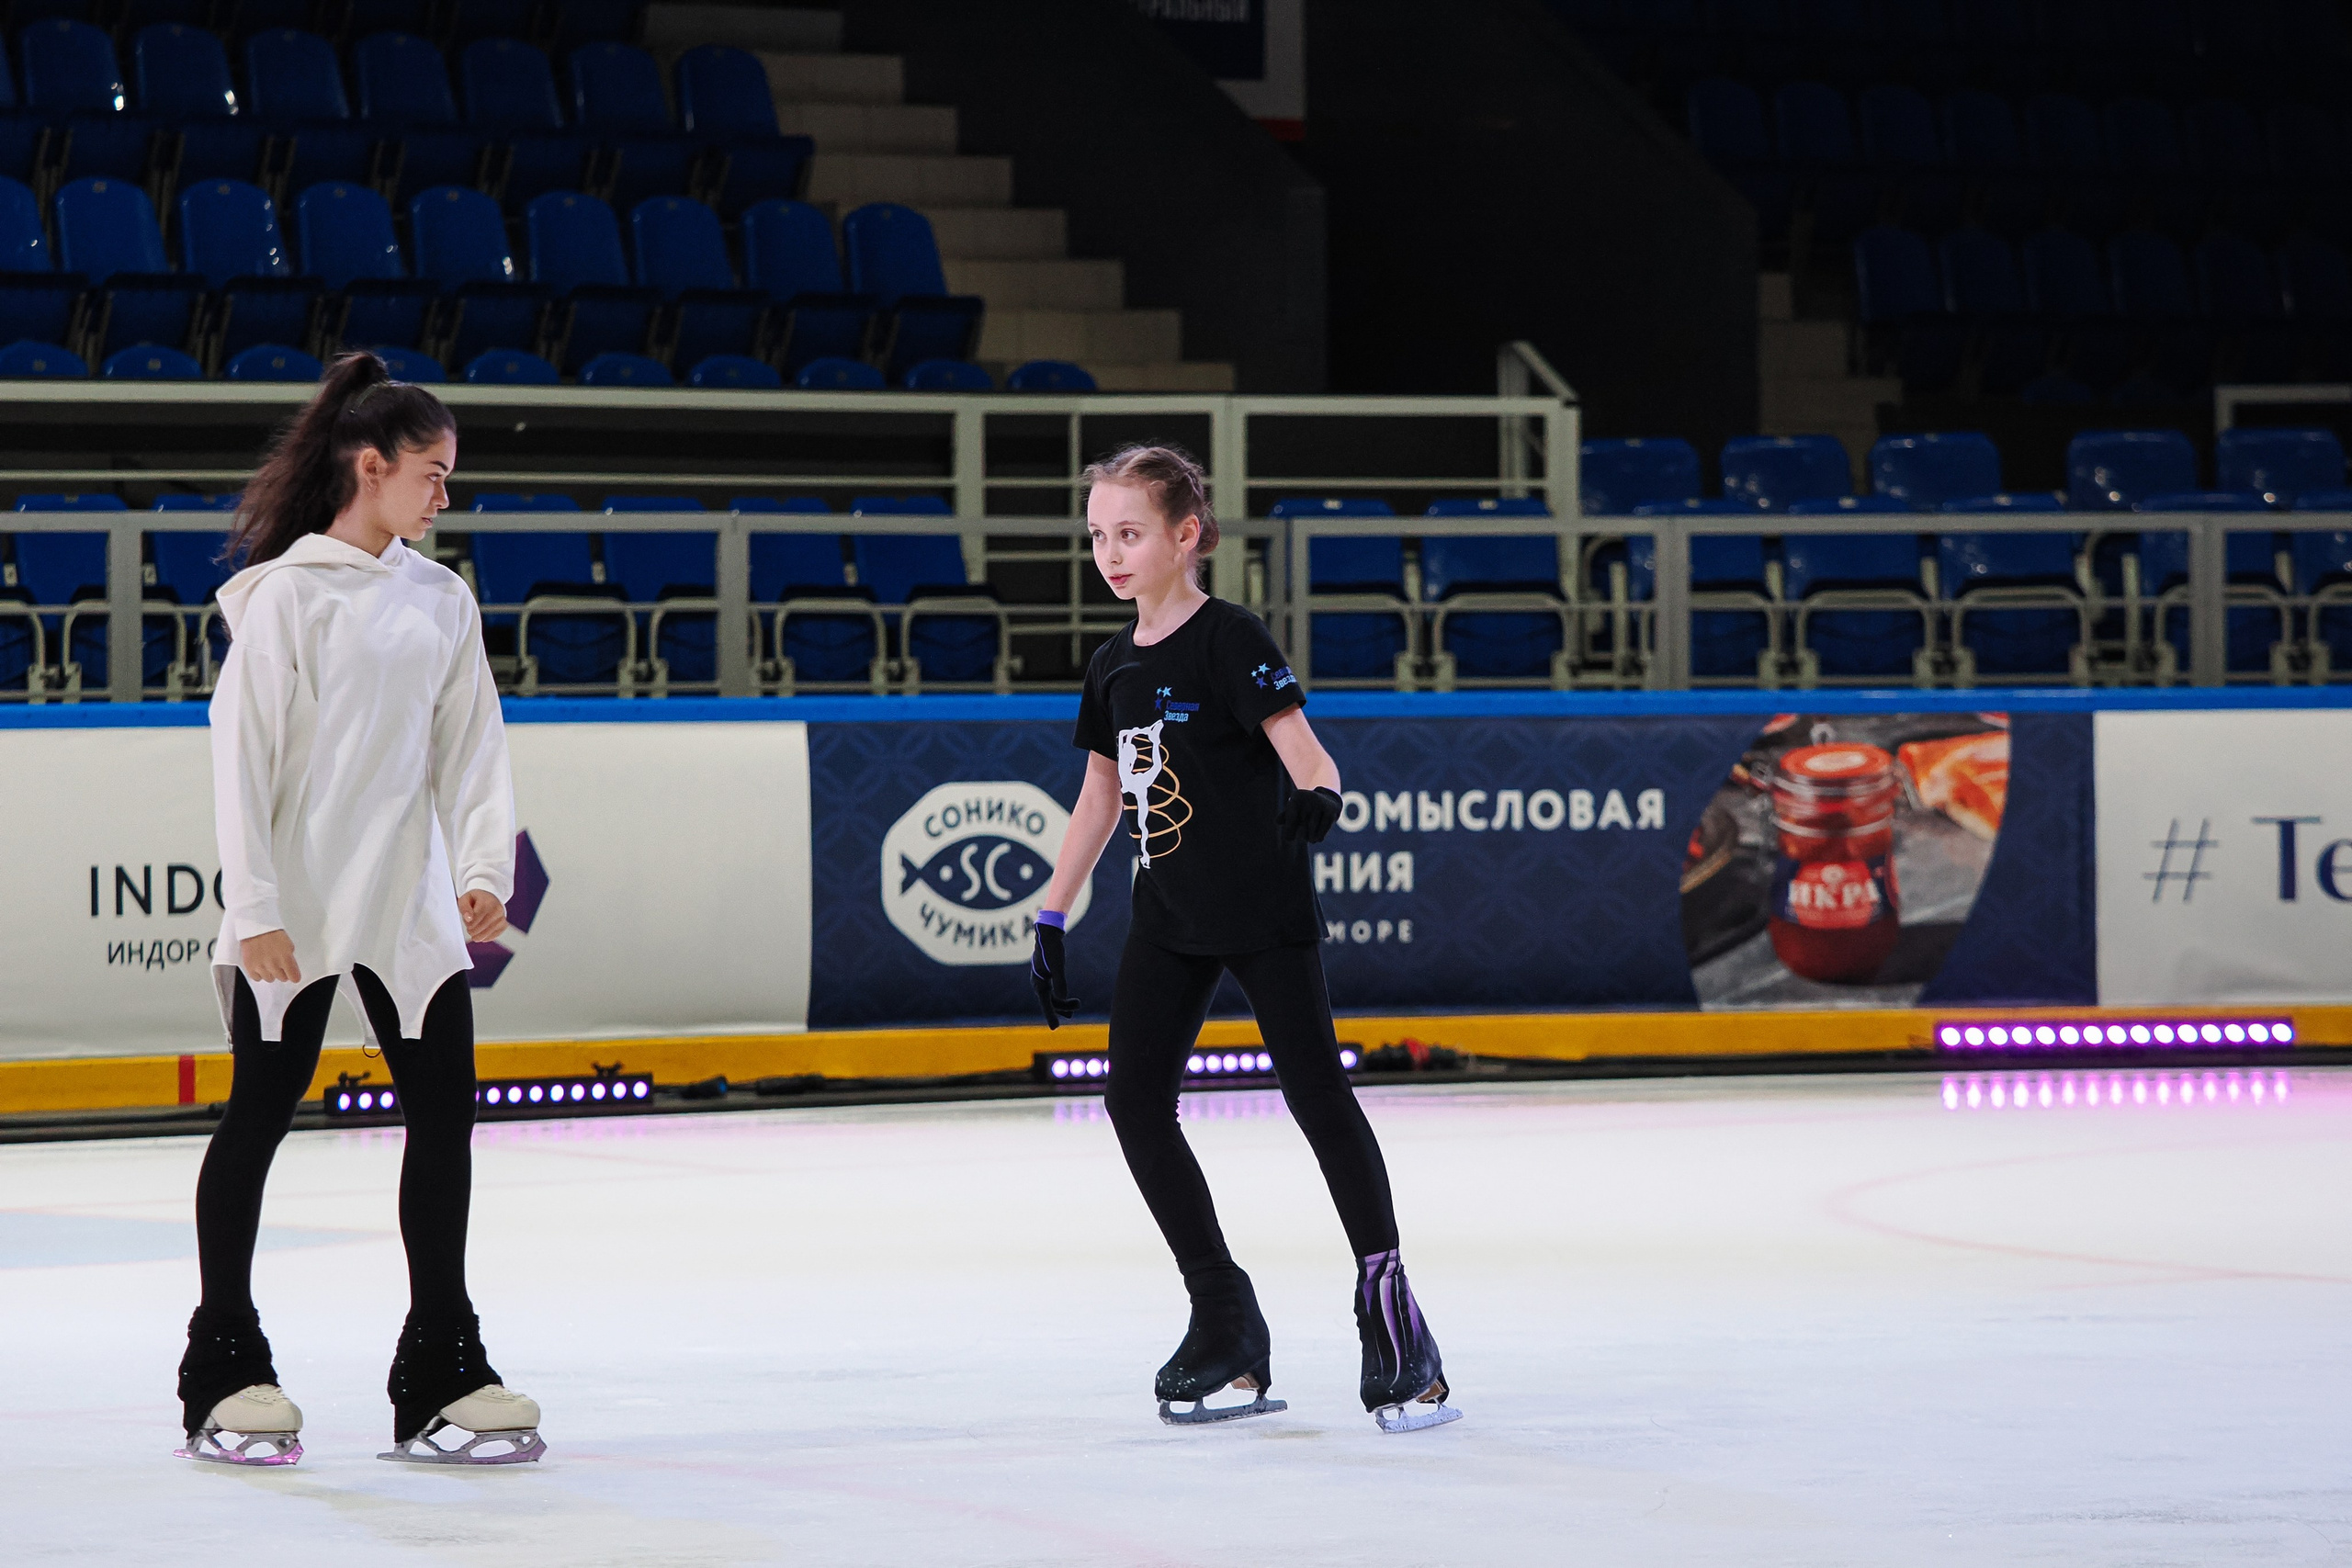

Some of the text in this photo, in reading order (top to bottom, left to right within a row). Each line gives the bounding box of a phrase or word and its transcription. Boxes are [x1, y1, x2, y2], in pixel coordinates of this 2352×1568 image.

[1164, 710, 1190, 722] Звезда
[924, 798, 1046, 838] СОНИКО
[1337, 789, 1665, 832] ОМЫСЛОВАЯ
[90, 863, 225, 917] IND
[960, 842, 1012, 902] SC
[1314, 852, 1414, 894] НИЯ
[921, 904, 1042, 948] ЧУМИКА
[108, 939, 200, 971] ИНДОР
